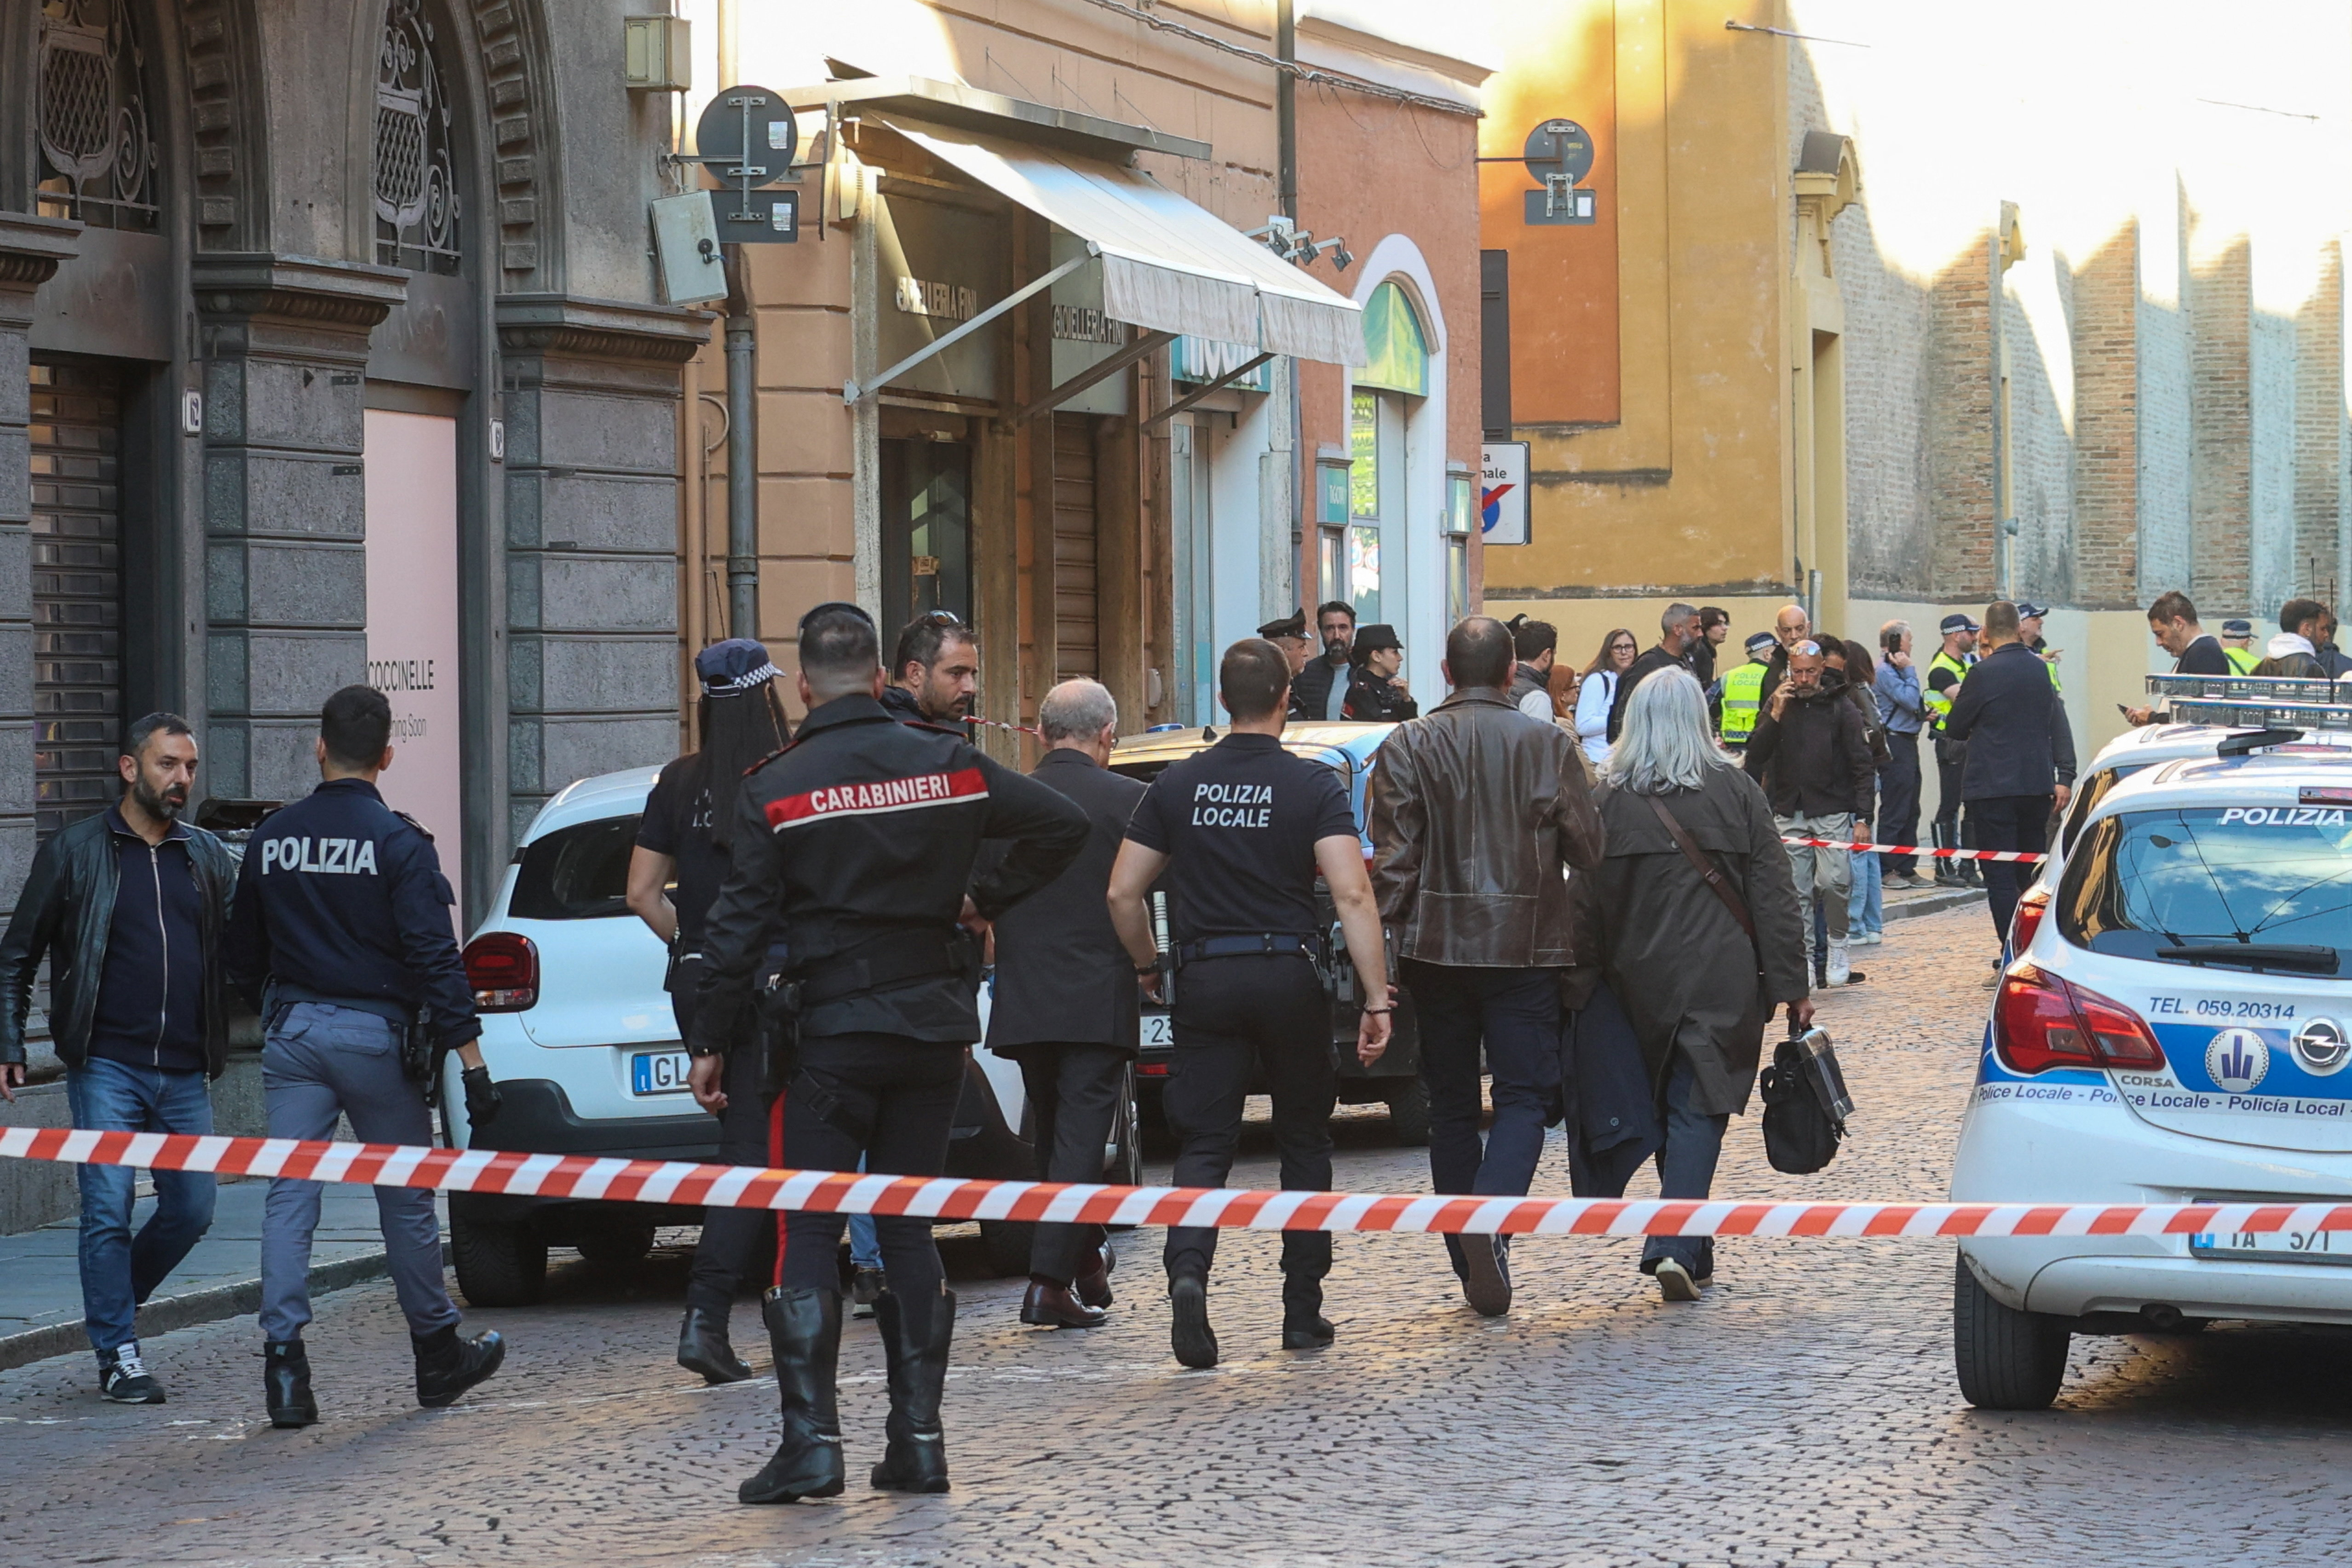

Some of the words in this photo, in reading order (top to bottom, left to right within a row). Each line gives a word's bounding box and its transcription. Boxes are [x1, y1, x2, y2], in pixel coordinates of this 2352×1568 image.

[1053, 305, 1106, 343] GIOIELLERIA
[1481, 467, 1507, 478] nale
[368, 660, 434, 692] COCCINELLE
[408, 713, 426, 737] Soon
[811, 775, 950, 812] CARABINIERI
[1194, 784, 1272, 804] POLIZIA
[1192, 807, 1271, 827] LOCALE
[2220, 808, 2345, 827] POLIZIA
[262, 837, 378, 875] POLIZIA
[2150, 997, 2189, 1014] TEL.
[2197, 999, 2294, 1020] 059.20314
[2121, 1075, 2174, 1088] CORSA
[1978, 1086, 2011, 1101] Police
[2015, 1085, 2072, 1100] Locale
[2151, 1092, 2209, 1109] Locale
[2228, 1096, 2289, 1113] Policía
[2294, 1100, 2346, 1116] Local
